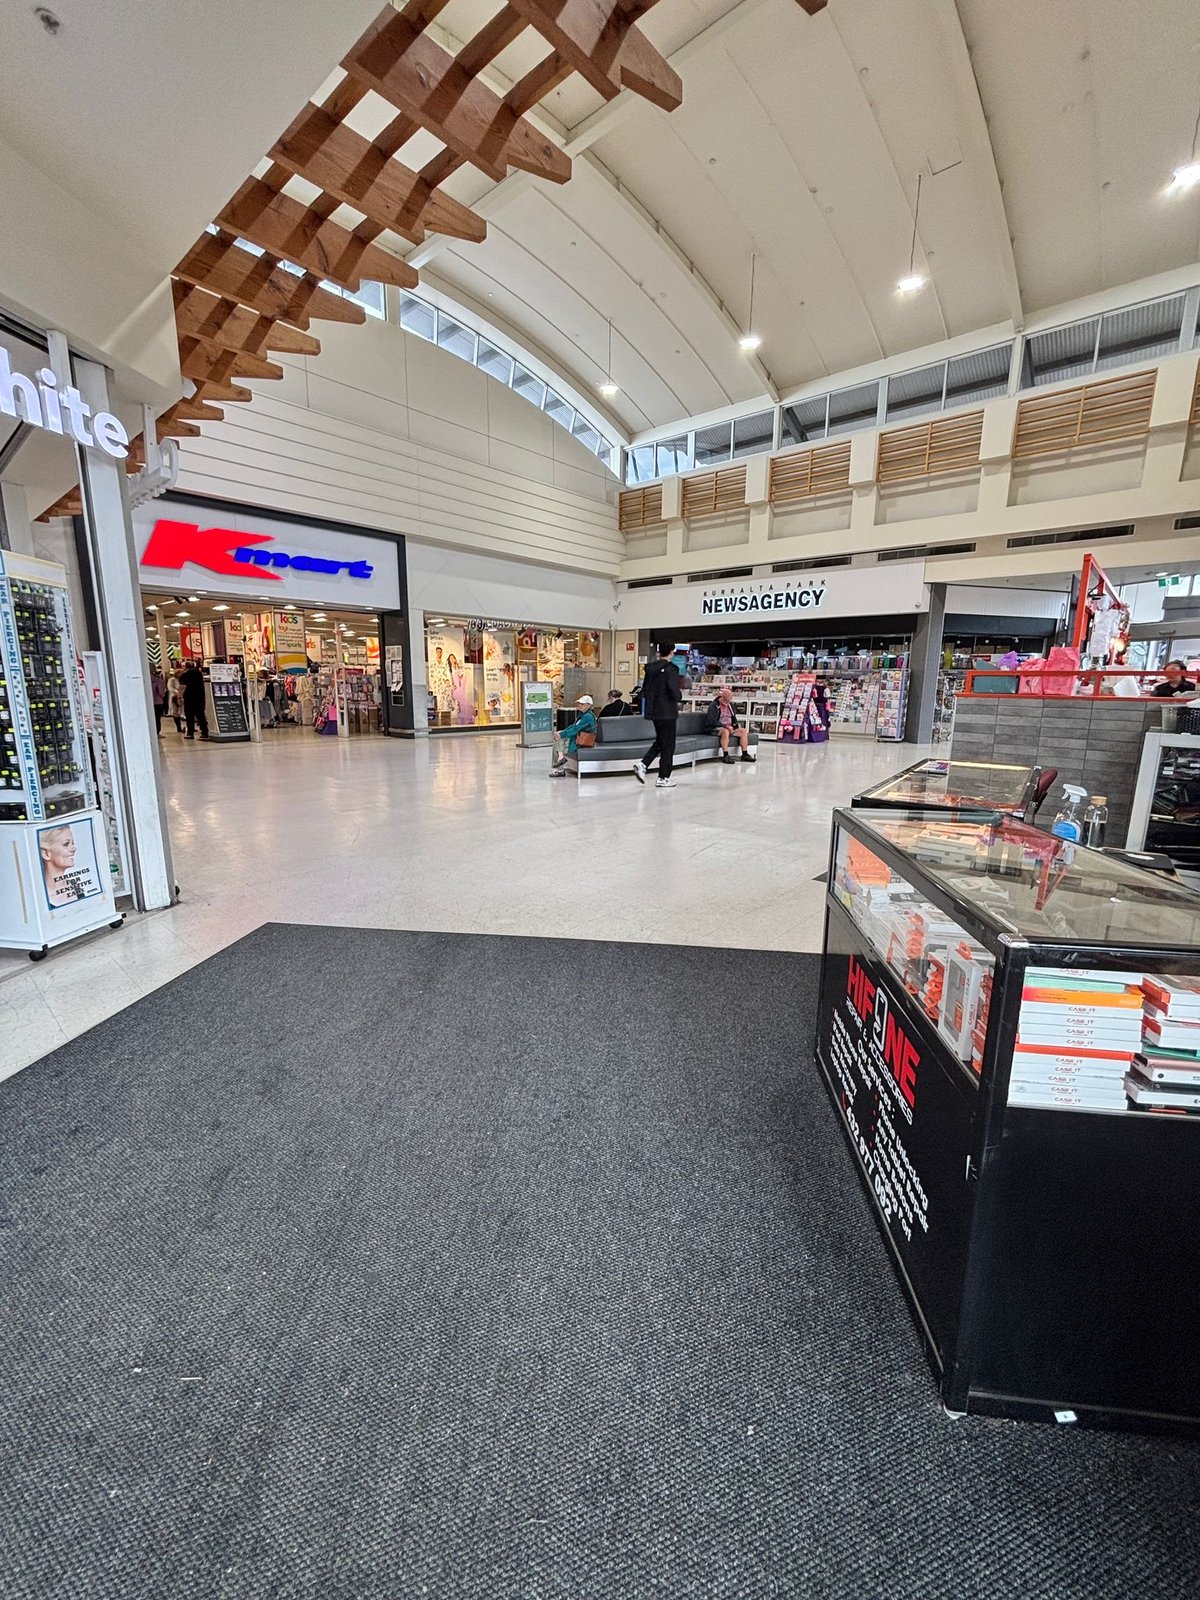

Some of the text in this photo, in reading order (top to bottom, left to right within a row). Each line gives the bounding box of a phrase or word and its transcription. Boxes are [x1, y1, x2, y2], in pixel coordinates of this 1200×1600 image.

[0, 346, 129, 459] hite
[141, 519, 374, 581] Kmart
[702, 589, 825, 614] NEWSAGENCY
[704, 579, 826, 597] KURRALTA PARK
[229, 621, 242, 632] kid
[23, 741, 41, 815] EAR PIERCING
[53, 867, 90, 883] EARRINGS
[55, 879, 93, 895] SENSITIVE
[66, 876, 81, 885] FOR
[67, 888, 85, 898] EARS
[858, 1039, 867, 1064] Our
[858, 1058, 871, 1093] Repair
[869, 1039, 913, 1126] ACCESSORIES
[859, 1136, 874, 1176] 977
[875, 1175, 891, 1223] 092
[875, 1132, 913, 1224] Home Buttons
[877, 1118, 928, 1232] Any Tablet Repair
[879, 1100, 928, 1212] Phone Unlocking
[873, 1149, 911, 1241] Charging Port
